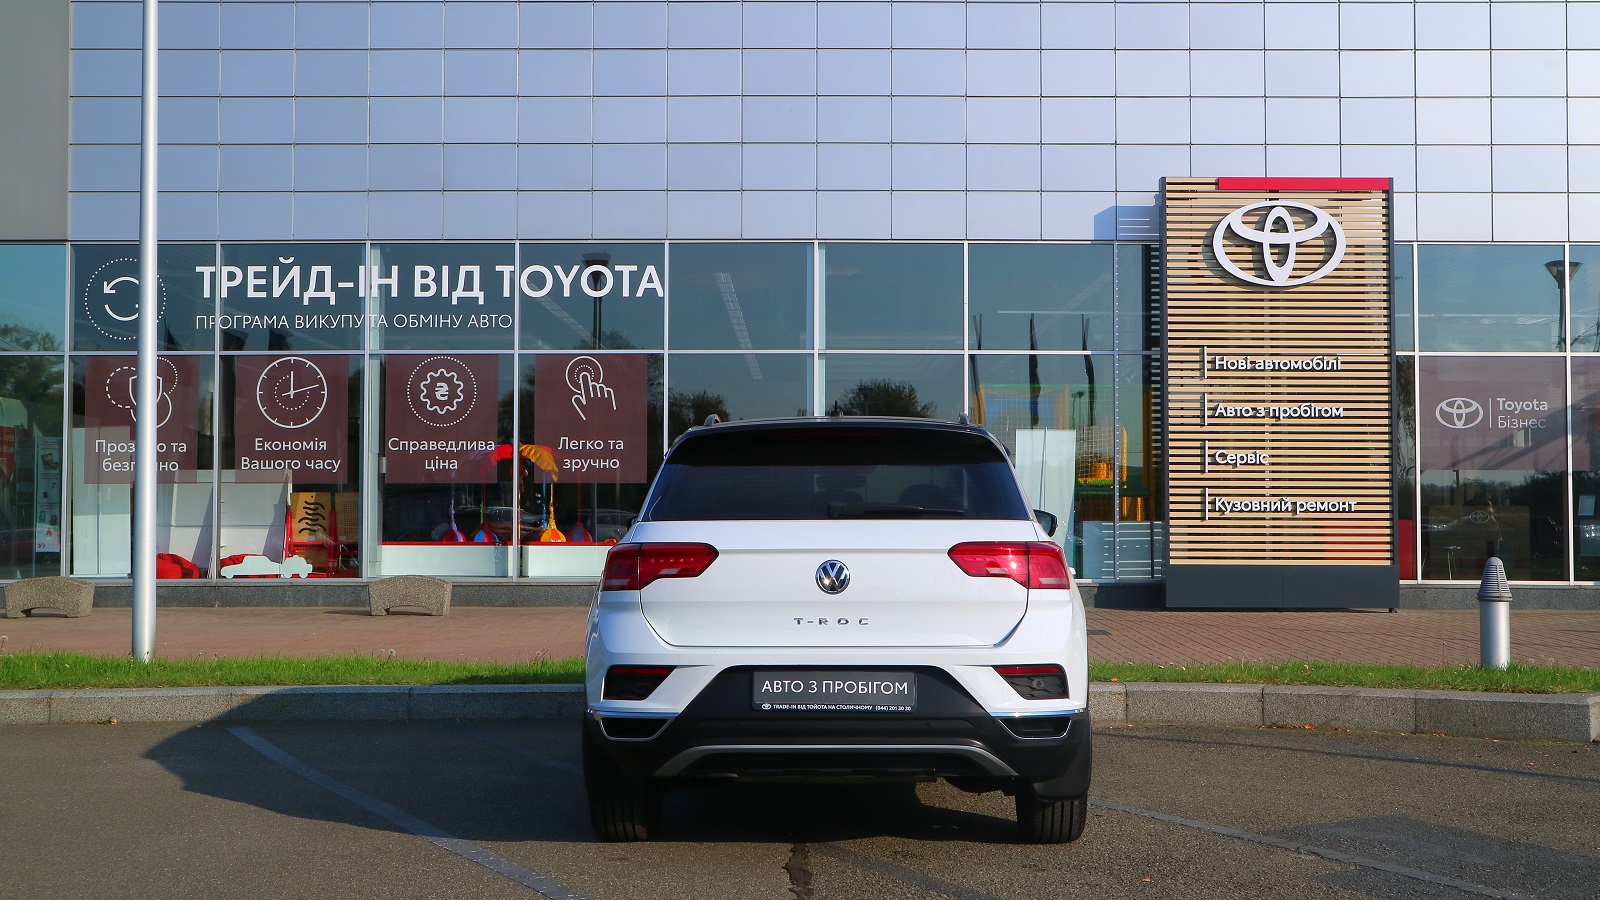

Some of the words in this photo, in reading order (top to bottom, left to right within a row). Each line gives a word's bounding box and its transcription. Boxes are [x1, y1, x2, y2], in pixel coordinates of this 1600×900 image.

[195, 256, 399, 306] ТРЕЙД-ІН
[414, 265, 484, 305] ВІД
[495, 264, 664, 298] TOYOTA
[196, 315, 289, 329] ПРОГРАМА
[295, 313, 365, 329] ВИКУПУ
[369, 314, 388, 328] ТА
[393, 314, 463, 328] ОБМІНУ
[467, 314, 512, 328] АВТО
[1215, 356, 1251, 370] Нові
[1255, 356, 1342, 371] автомобілі
[1215, 403, 1251, 417] Авто
[1256, 407, 1265, 417] з
[1269, 403, 1344, 420] пробігом
[1496, 398, 1548, 414] Toyota
[1498, 416, 1546, 429] Бізнес
[95, 439, 167, 455] Прозо
[170, 443, 187, 453] та
[255, 438, 327, 451] Економія
[388, 438, 495, 453] Справедлива
[558, 437, 604, 450] Легко
[607, 440, 624, 450] та
[241, 457, 301, 470] Вашого
[305, 460, 341, 472] часу
[425, 456, 458, 471] ціна
[563, 457, 620, 472] зручно
[1215, 450, 1269, 467] Сервіс
[1215, 497, 1292, 514] Кузовний
[1297, 501, 1357, 515] ремонт
[761, 680, 804, 693] АВТО
[822, 680, 908, 695] ПРОБІГОМ
